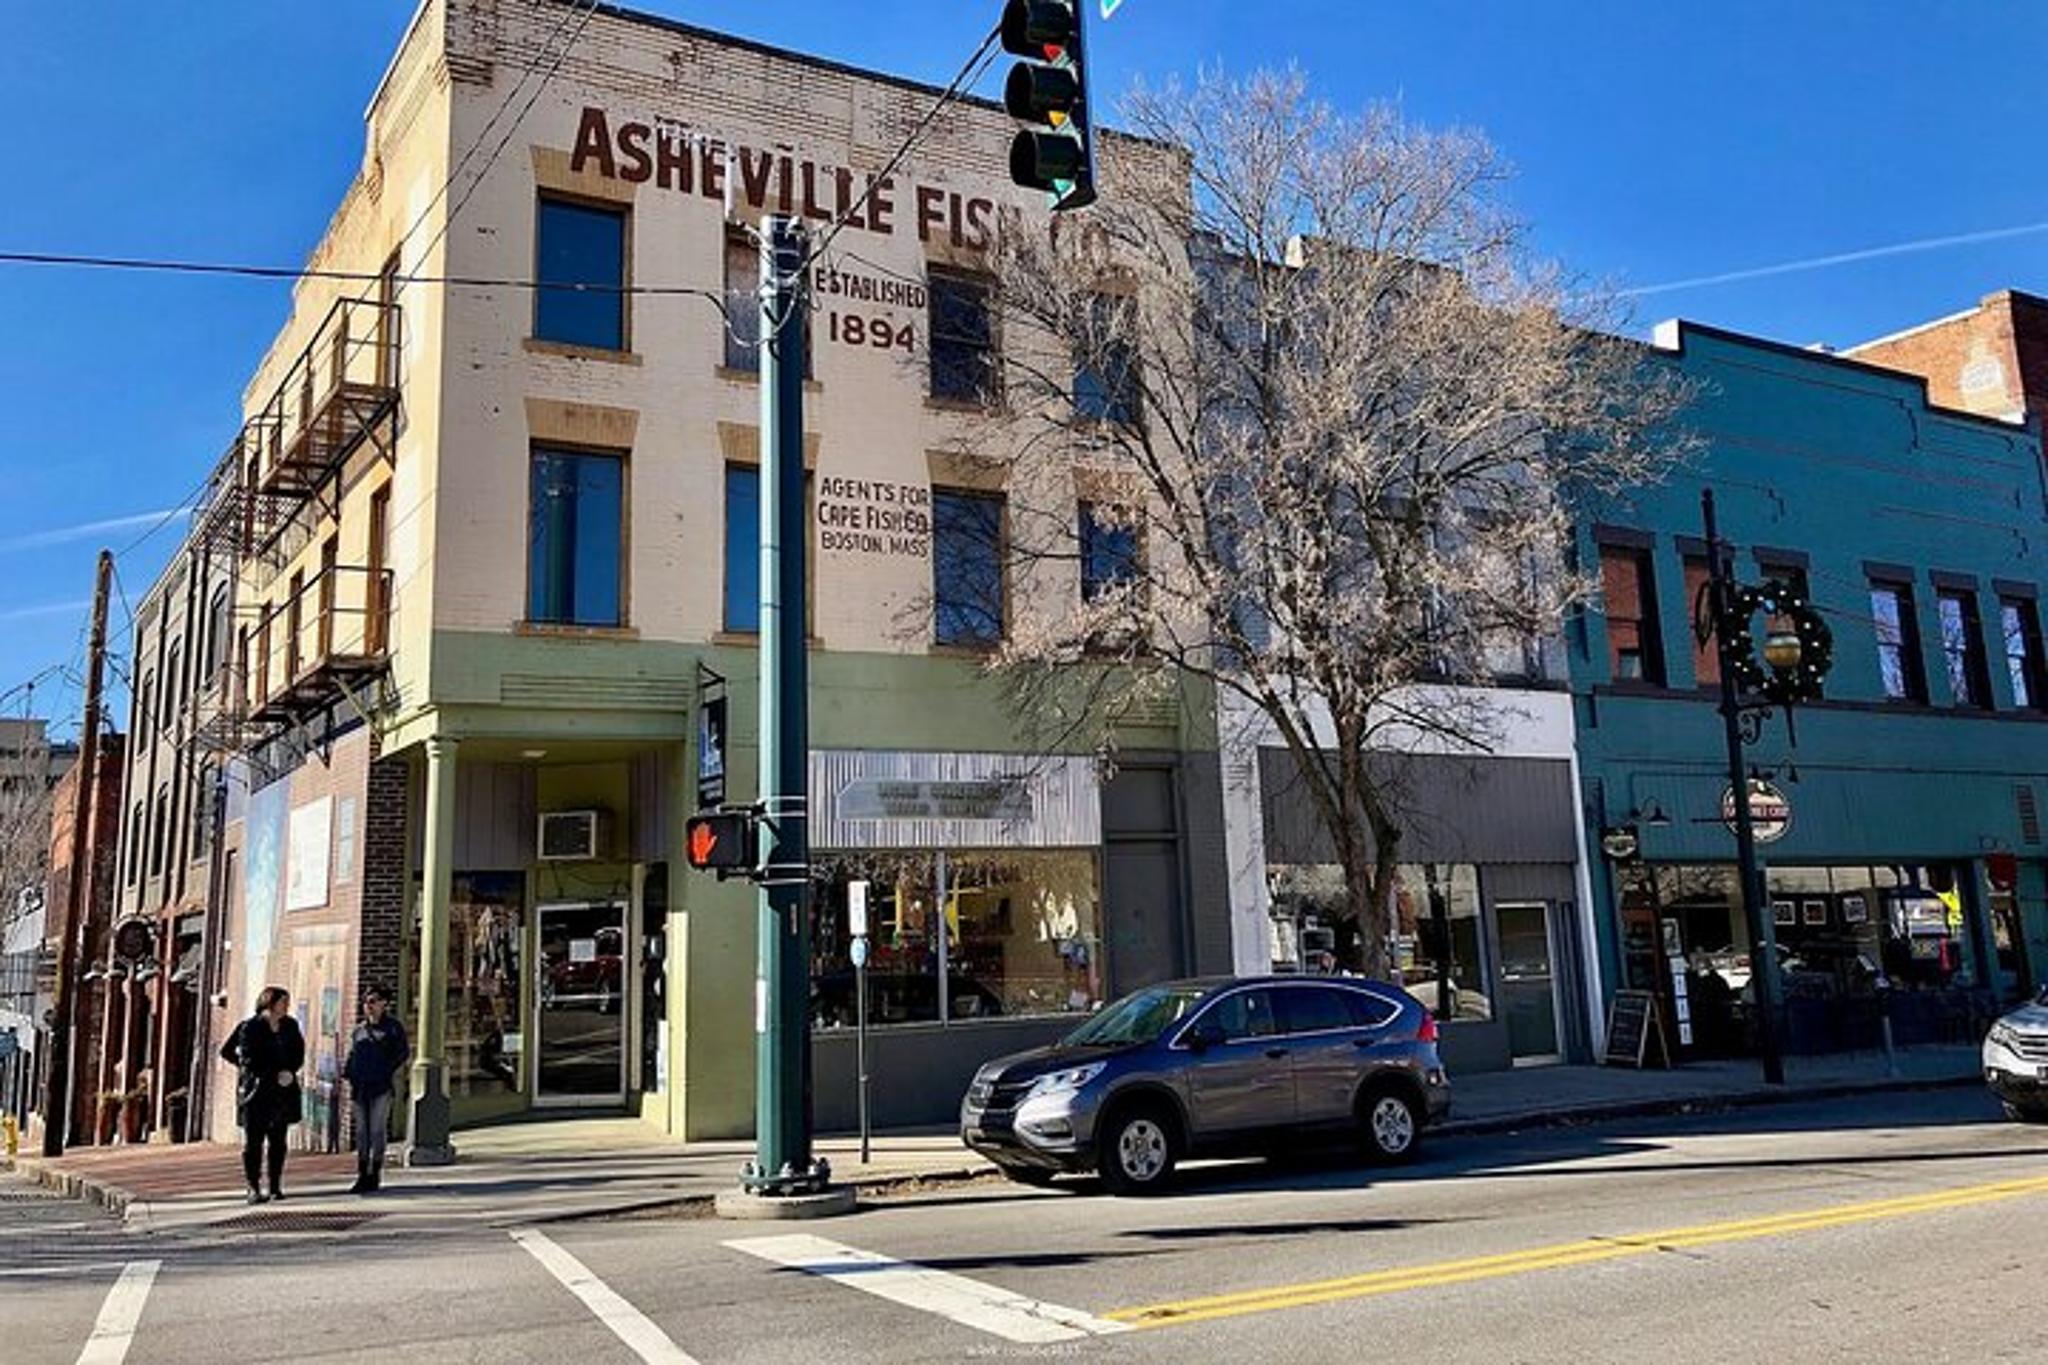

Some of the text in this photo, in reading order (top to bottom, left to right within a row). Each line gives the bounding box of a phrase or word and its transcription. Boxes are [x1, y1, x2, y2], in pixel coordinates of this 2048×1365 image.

[570, 106, 894, 234] ASHEVILLE
[816, 267, 926, 308] ESTABLISHED
[829, 311, 915, 353] 1894
[821, 477, 929, 506] AGENTS FOR
[818, 501, 861, 529] CAPE
[866, 505, 902, 532] FISH
